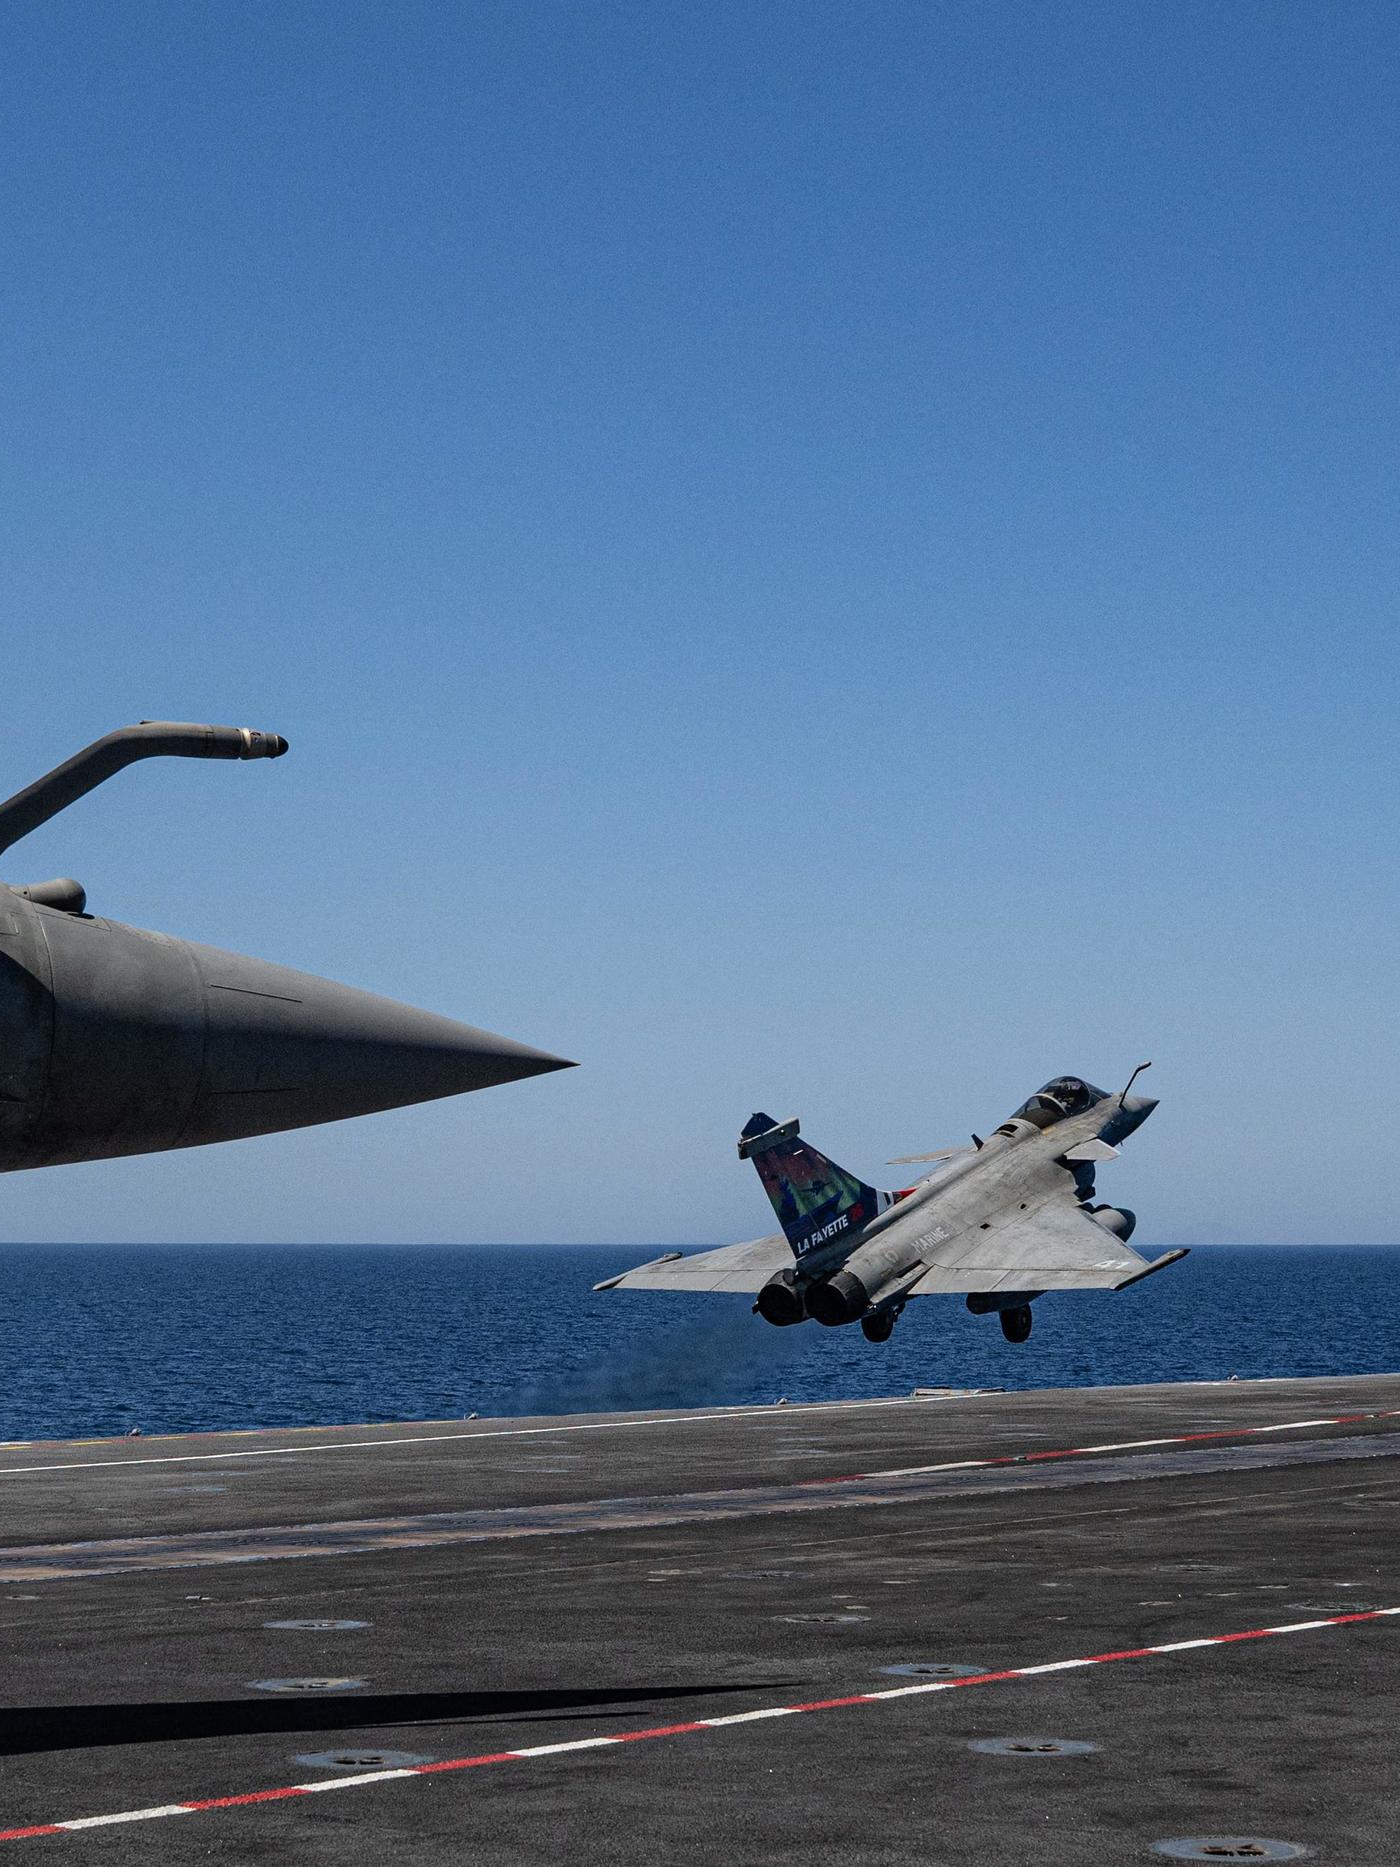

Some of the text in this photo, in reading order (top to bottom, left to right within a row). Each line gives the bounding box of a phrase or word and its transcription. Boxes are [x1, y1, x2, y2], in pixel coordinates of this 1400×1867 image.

[797, 1214, 849, 1254] LA FAYETTE
[911, 1226, 950, 1254] MARINE
